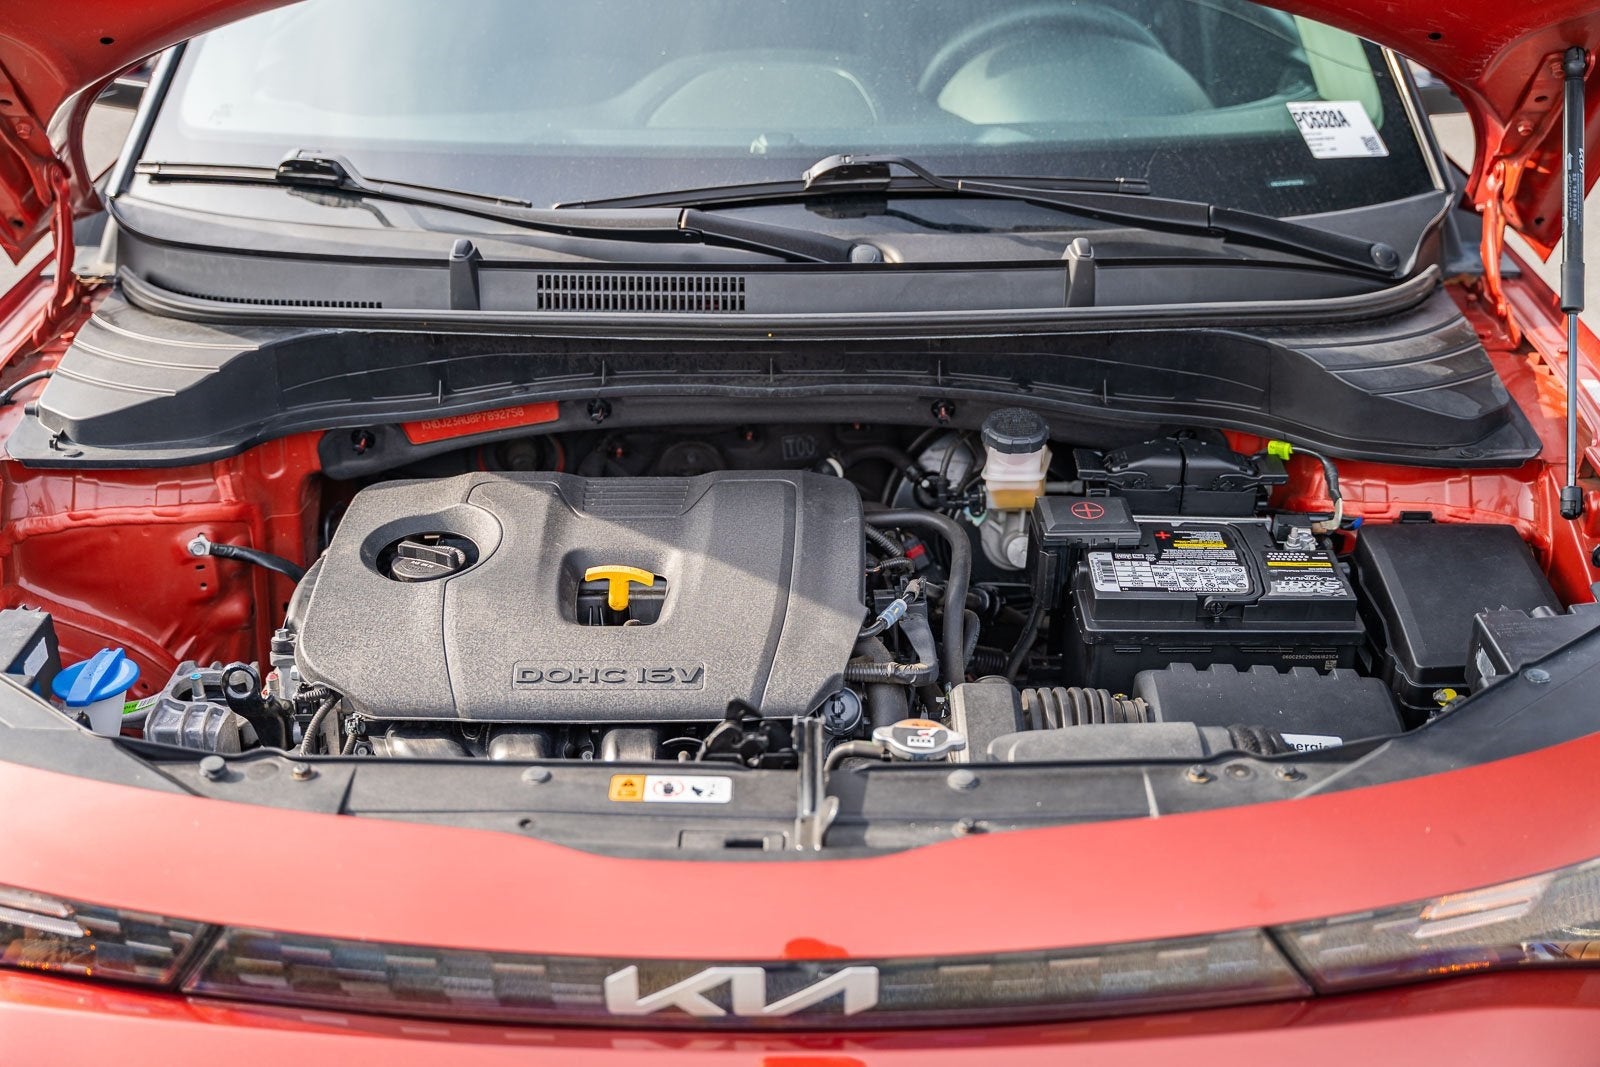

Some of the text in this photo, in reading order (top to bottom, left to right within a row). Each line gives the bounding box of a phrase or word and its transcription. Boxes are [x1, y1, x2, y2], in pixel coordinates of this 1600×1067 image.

[1293, 109, 1351, 129] PC6328A
[516, 667, 705, 684] DOHC 16V
[604, 964, 879, 1017] KIA
